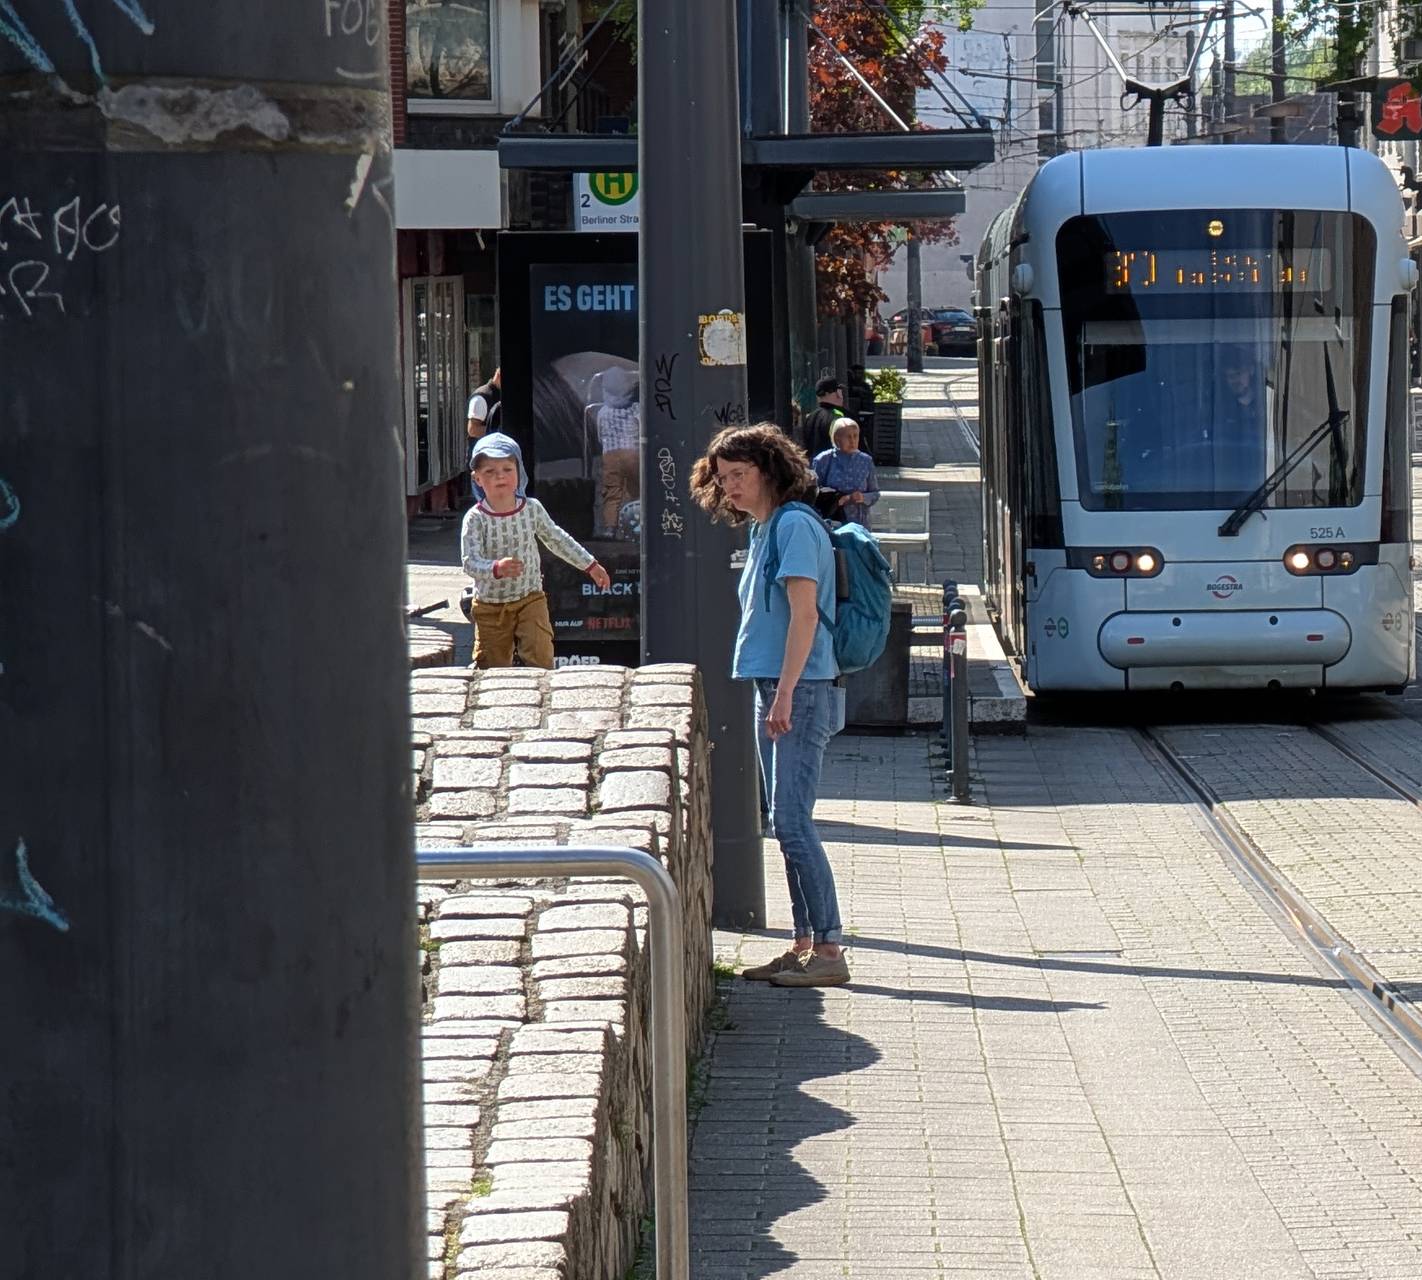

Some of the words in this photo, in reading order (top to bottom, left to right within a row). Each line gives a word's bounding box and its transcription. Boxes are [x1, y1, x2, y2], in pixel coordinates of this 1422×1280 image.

[580, 193, 591, 208] 2
[581, 214, 618, 225] Berliner
[544, 285, 571, 311] ES
[576, 285, 635, 311] GEHT
[1310, 527, 1334, 539] 525
[1336, 528, 1346, 538] A
[582, 583, 633, 595] BLACK
[1206, 582, 1244, 592] BOGESTRA
[587, 617, 632, 630] NETFLIX
[553, 655, 600, 667] TRÖER
